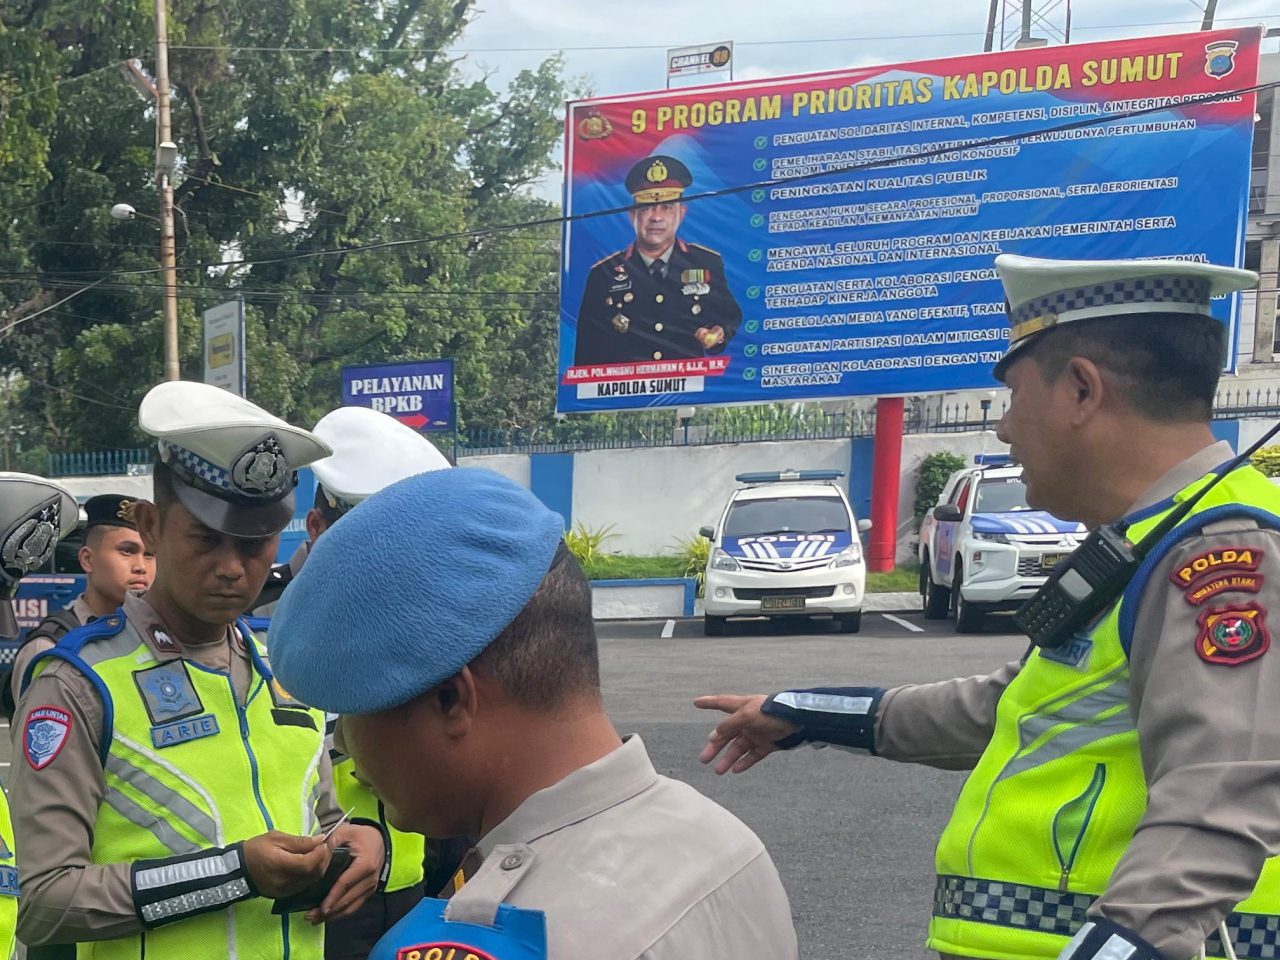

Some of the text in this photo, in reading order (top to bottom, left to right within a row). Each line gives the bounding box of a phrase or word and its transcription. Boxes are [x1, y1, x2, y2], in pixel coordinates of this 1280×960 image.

[631, 52, 1183, 133] 9 PROGRAM PRIORITAS KAPOLDA SUMUT
[774, 130, 837, 146] PENGUATAN
[839, 122, 910, 139] SOLIDARITAS
[912, 116, 970, 131] INTERNAL,
[972, 108, 1049, 124] KOMPETENSI,
[1050, 103, 1102, 118] DISIPLIN,
[772, 151, 856, 168] PEMELIHARAAN
[858, 145, 920, 159] STABILITAS
[1107, 120, 1196, 136] PERTUMBUHAN
[929, 152, 960, 163] YANG
[961, 146, 1020, 160] KONDUSIF
[771, 170, 987, 199] PENINGKATAN KUALITAS PUBLIK
[770, 207, 828, 222] PENEGAKAN
[829, 204, 866, 217] HUKUM
[867, 201, 907, 213] SECARA
[1067, 183, 1099, 195] SERTA
[1101, 177, 1178, 193] BERORIENTASI
[768, 205, 978, 233] KEPADA KEADILAN & KEMANFAATAN HUKUM
[767, 216, 1176, 260] MENGAWAL SELURUH PROGRAM DAN KEBIJAKAN PEMERINTAH SERTA
[766, 243, 1002, 272] AGENDA NASIONAL DAN INTERNASIONAL
[766, 281, 834, 297] PENGUATAN
[836, 278, 874, 291] SERTA
[875, 271, 952, 287] KOLABORASI
[766, 286, 938, 308] TERHADAP KINERJA ANGGOTA
[763, 303, 1006, 330] PENGELOLAAN MEDIA YANG EFEKTIF, TRAN
[762, 339, 831, 355] PENGUATAN
[832, 335, 902, 350] PARTISIPASI
[904, 331, 944, 346] DALAM
[946, 328, 1000, 343] MITIGASI
[761, 363, 812, 377] SINERGI
[813, 360, 840, 374] DAN
[842, 356, 922, 371] KOLABORASI
[924, 352, 978, 366] DENGAN
[350, 374, 444, 396] PELAYANAN
[597, 378, 687, 397] KAPOLDA SUMUT
[761, 373, 842, 388] MASYARAKAT
[371, 396, 423, 413] BPKB
[738, 534, 835, 545] POLISI
[1179, 550, 1253, 581] POLDA
[161, 719, 212, 741] ARIE
